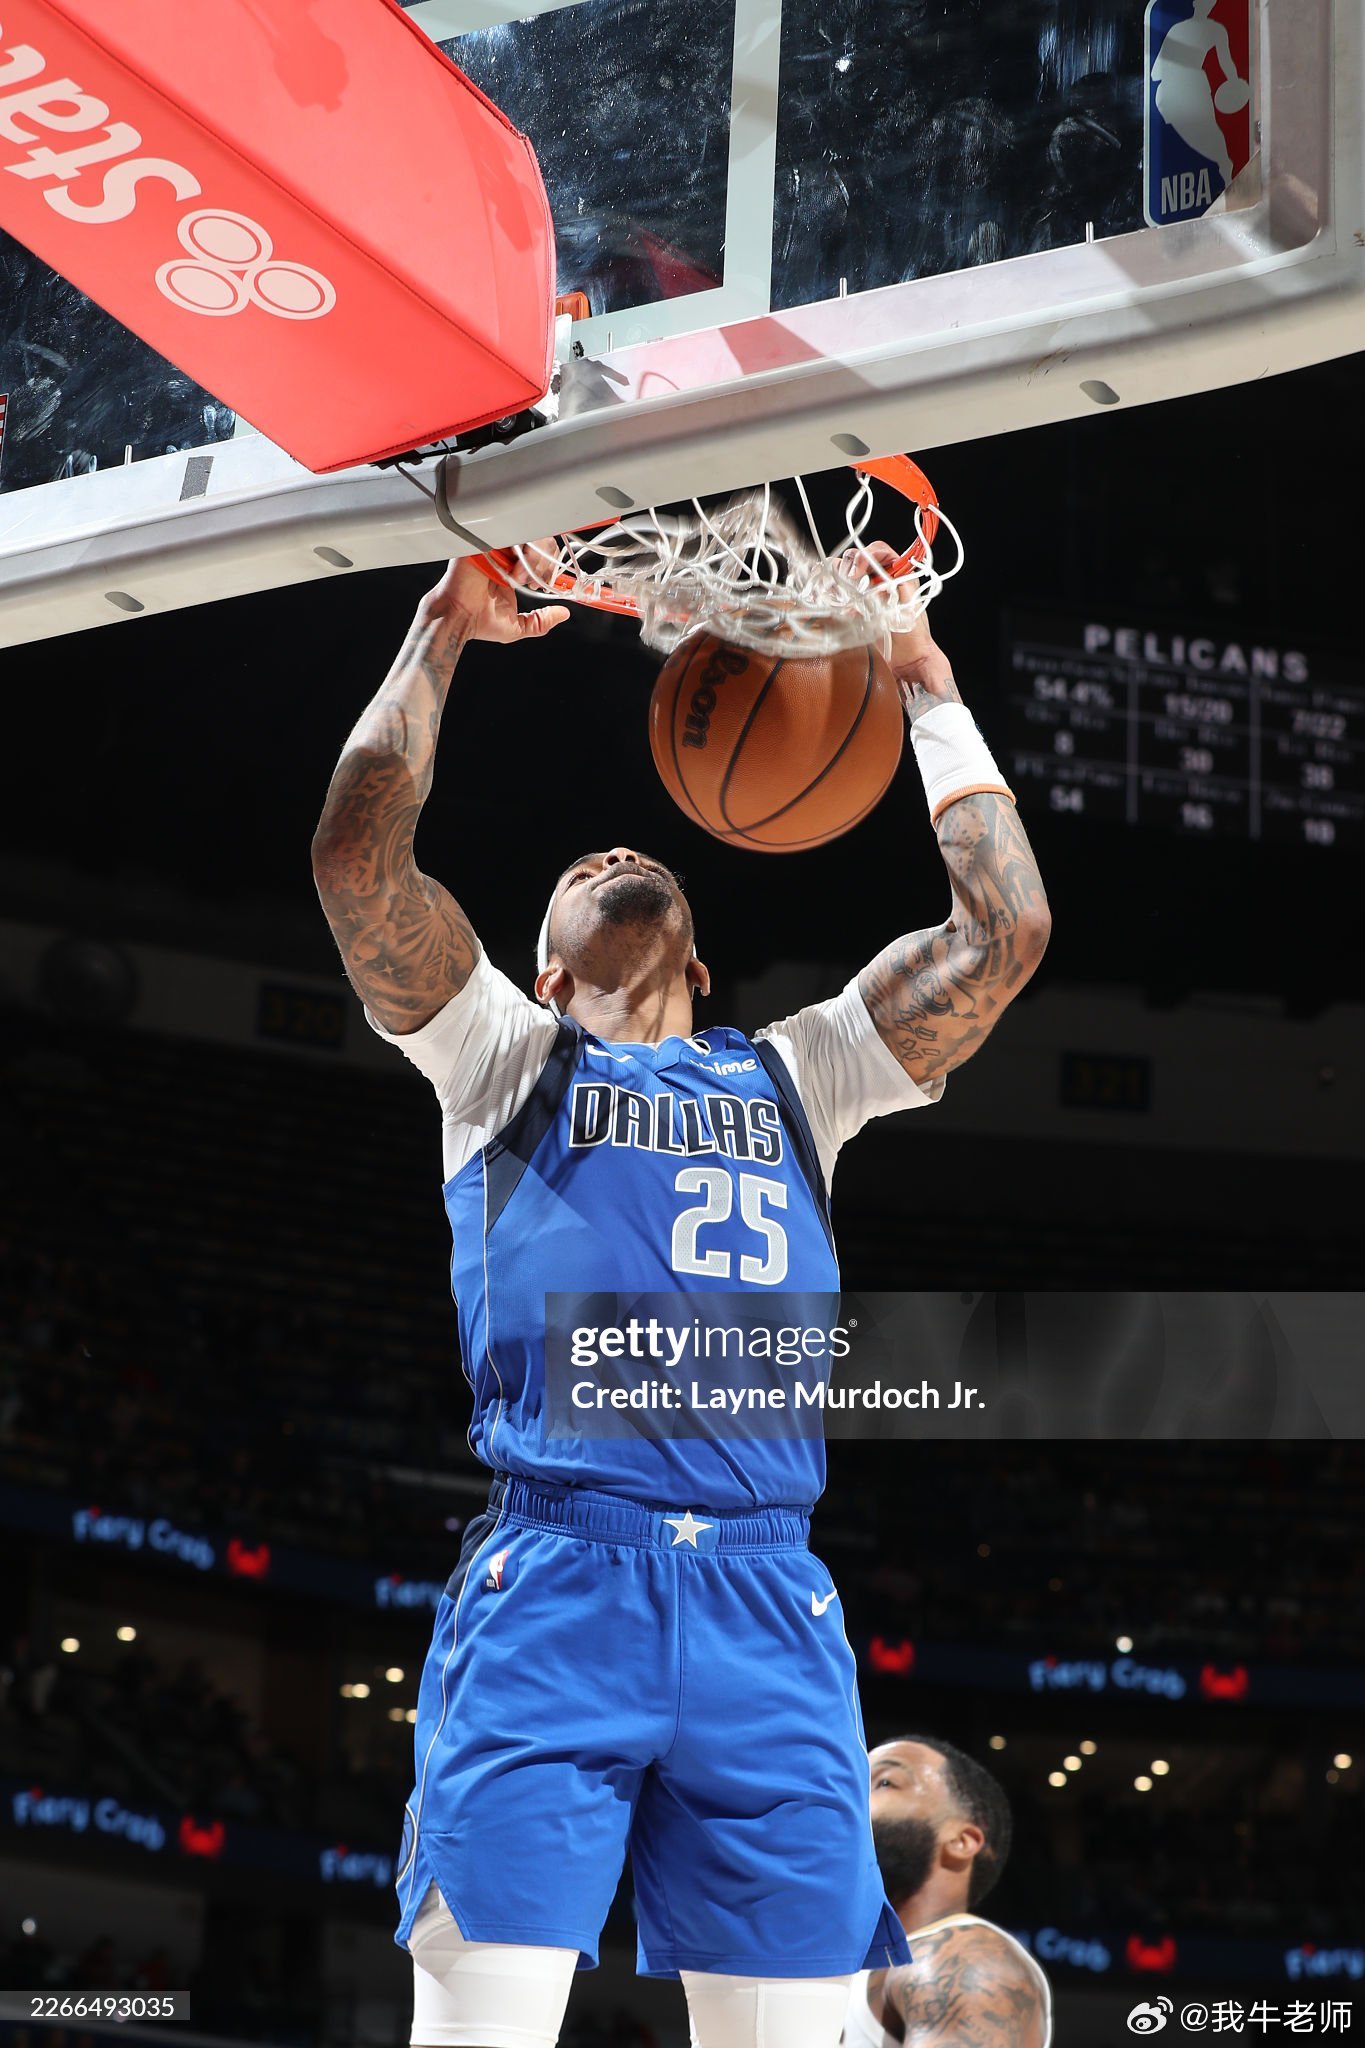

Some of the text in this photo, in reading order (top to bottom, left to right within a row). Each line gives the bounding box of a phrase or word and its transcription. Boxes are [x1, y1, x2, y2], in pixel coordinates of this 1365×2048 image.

[0, 24, 201, 224] Sta
[1161, 168, 1213, 215] NBA
[1084, 624, 1308, 683] PELICANS
[1050, 785, 1085, 813] 54
[568, 1082, 784, 1166] DALLAS
[671, 1167, 789, 1286] 25
[73, 1507, 215, 1571] Fiery Crab
[1029, 1656, 1186, 1699] Fiery Crab
[13, 1787, 165, 1850] Fiery Crab
[321, 1845, 391, 1888] Fiery
[1035, 1927, 1111, 1972] Crab
